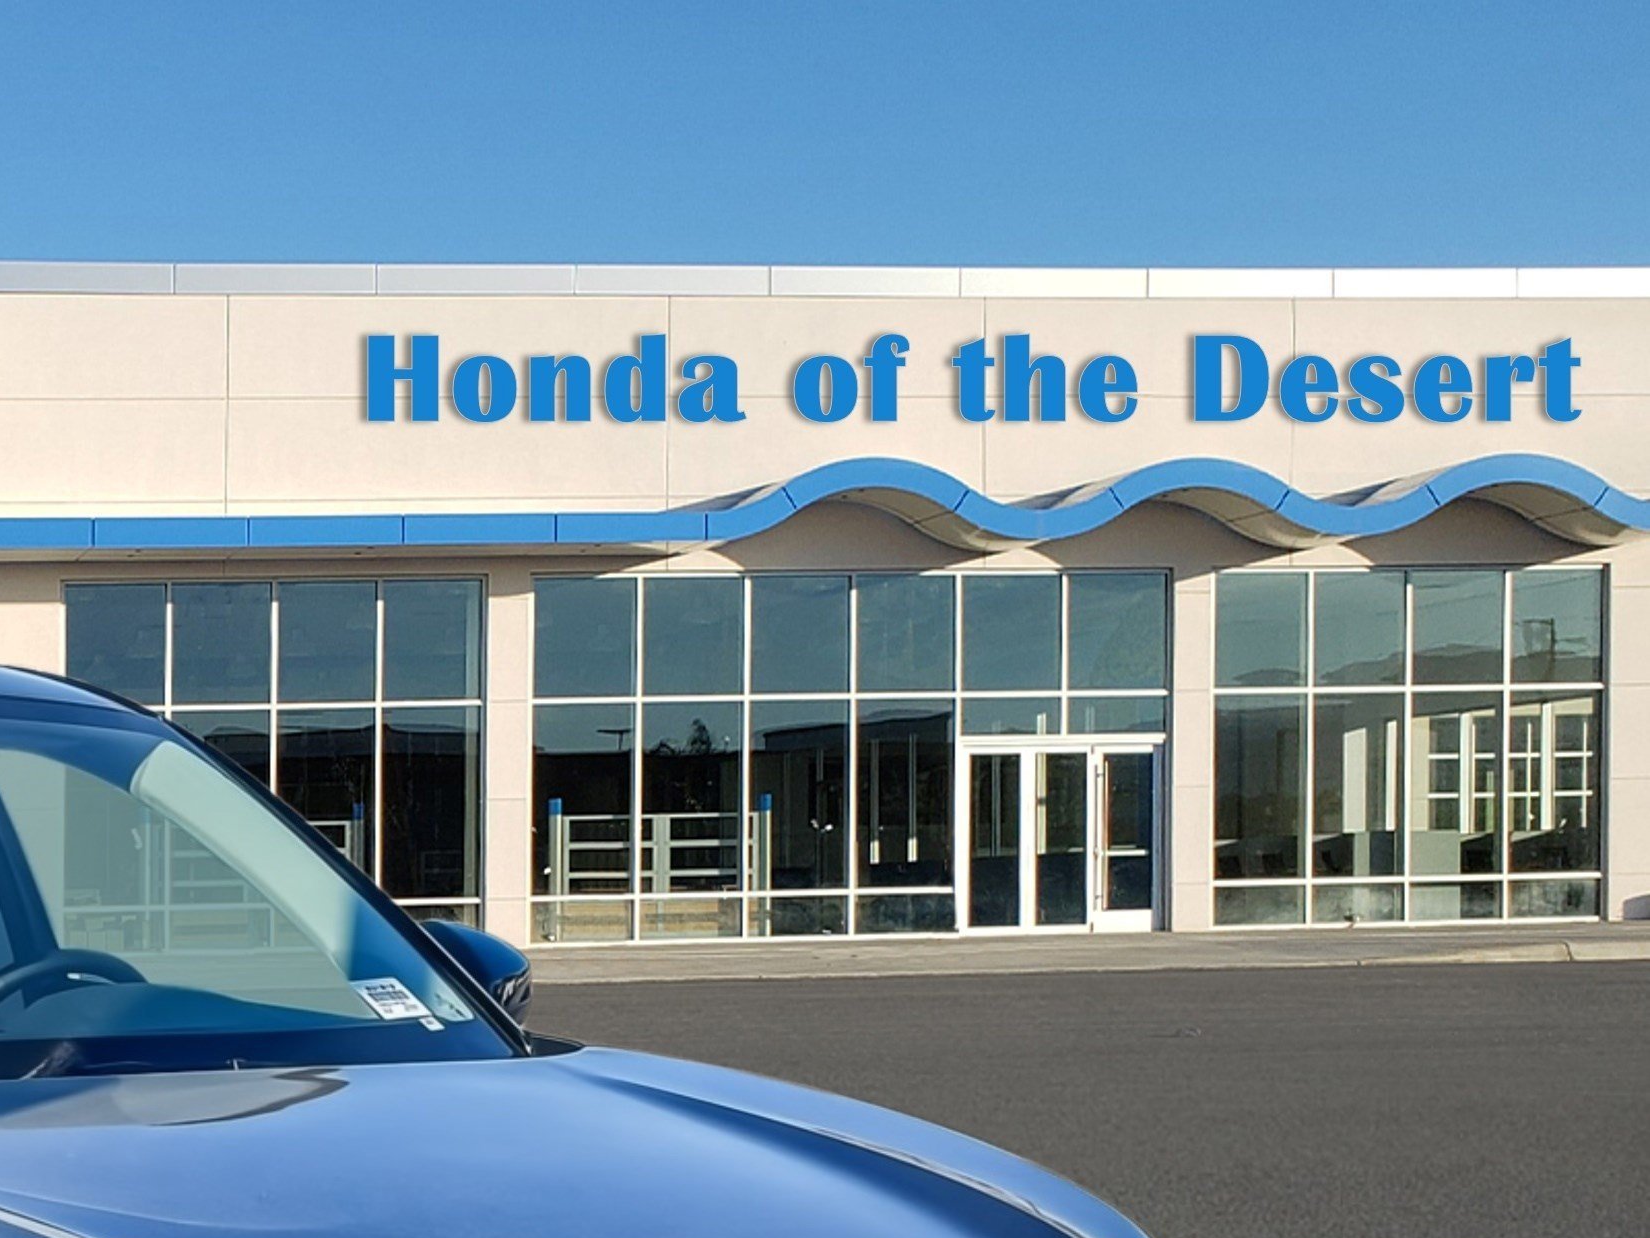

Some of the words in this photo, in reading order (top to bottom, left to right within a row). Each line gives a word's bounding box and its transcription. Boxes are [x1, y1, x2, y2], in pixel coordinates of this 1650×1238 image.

[363, 332, 747, 424] Honda
[792, 333, 911, 424] of
[951, 333, 1139, 424] the
[1193, 334, 1584, 424] Desert
